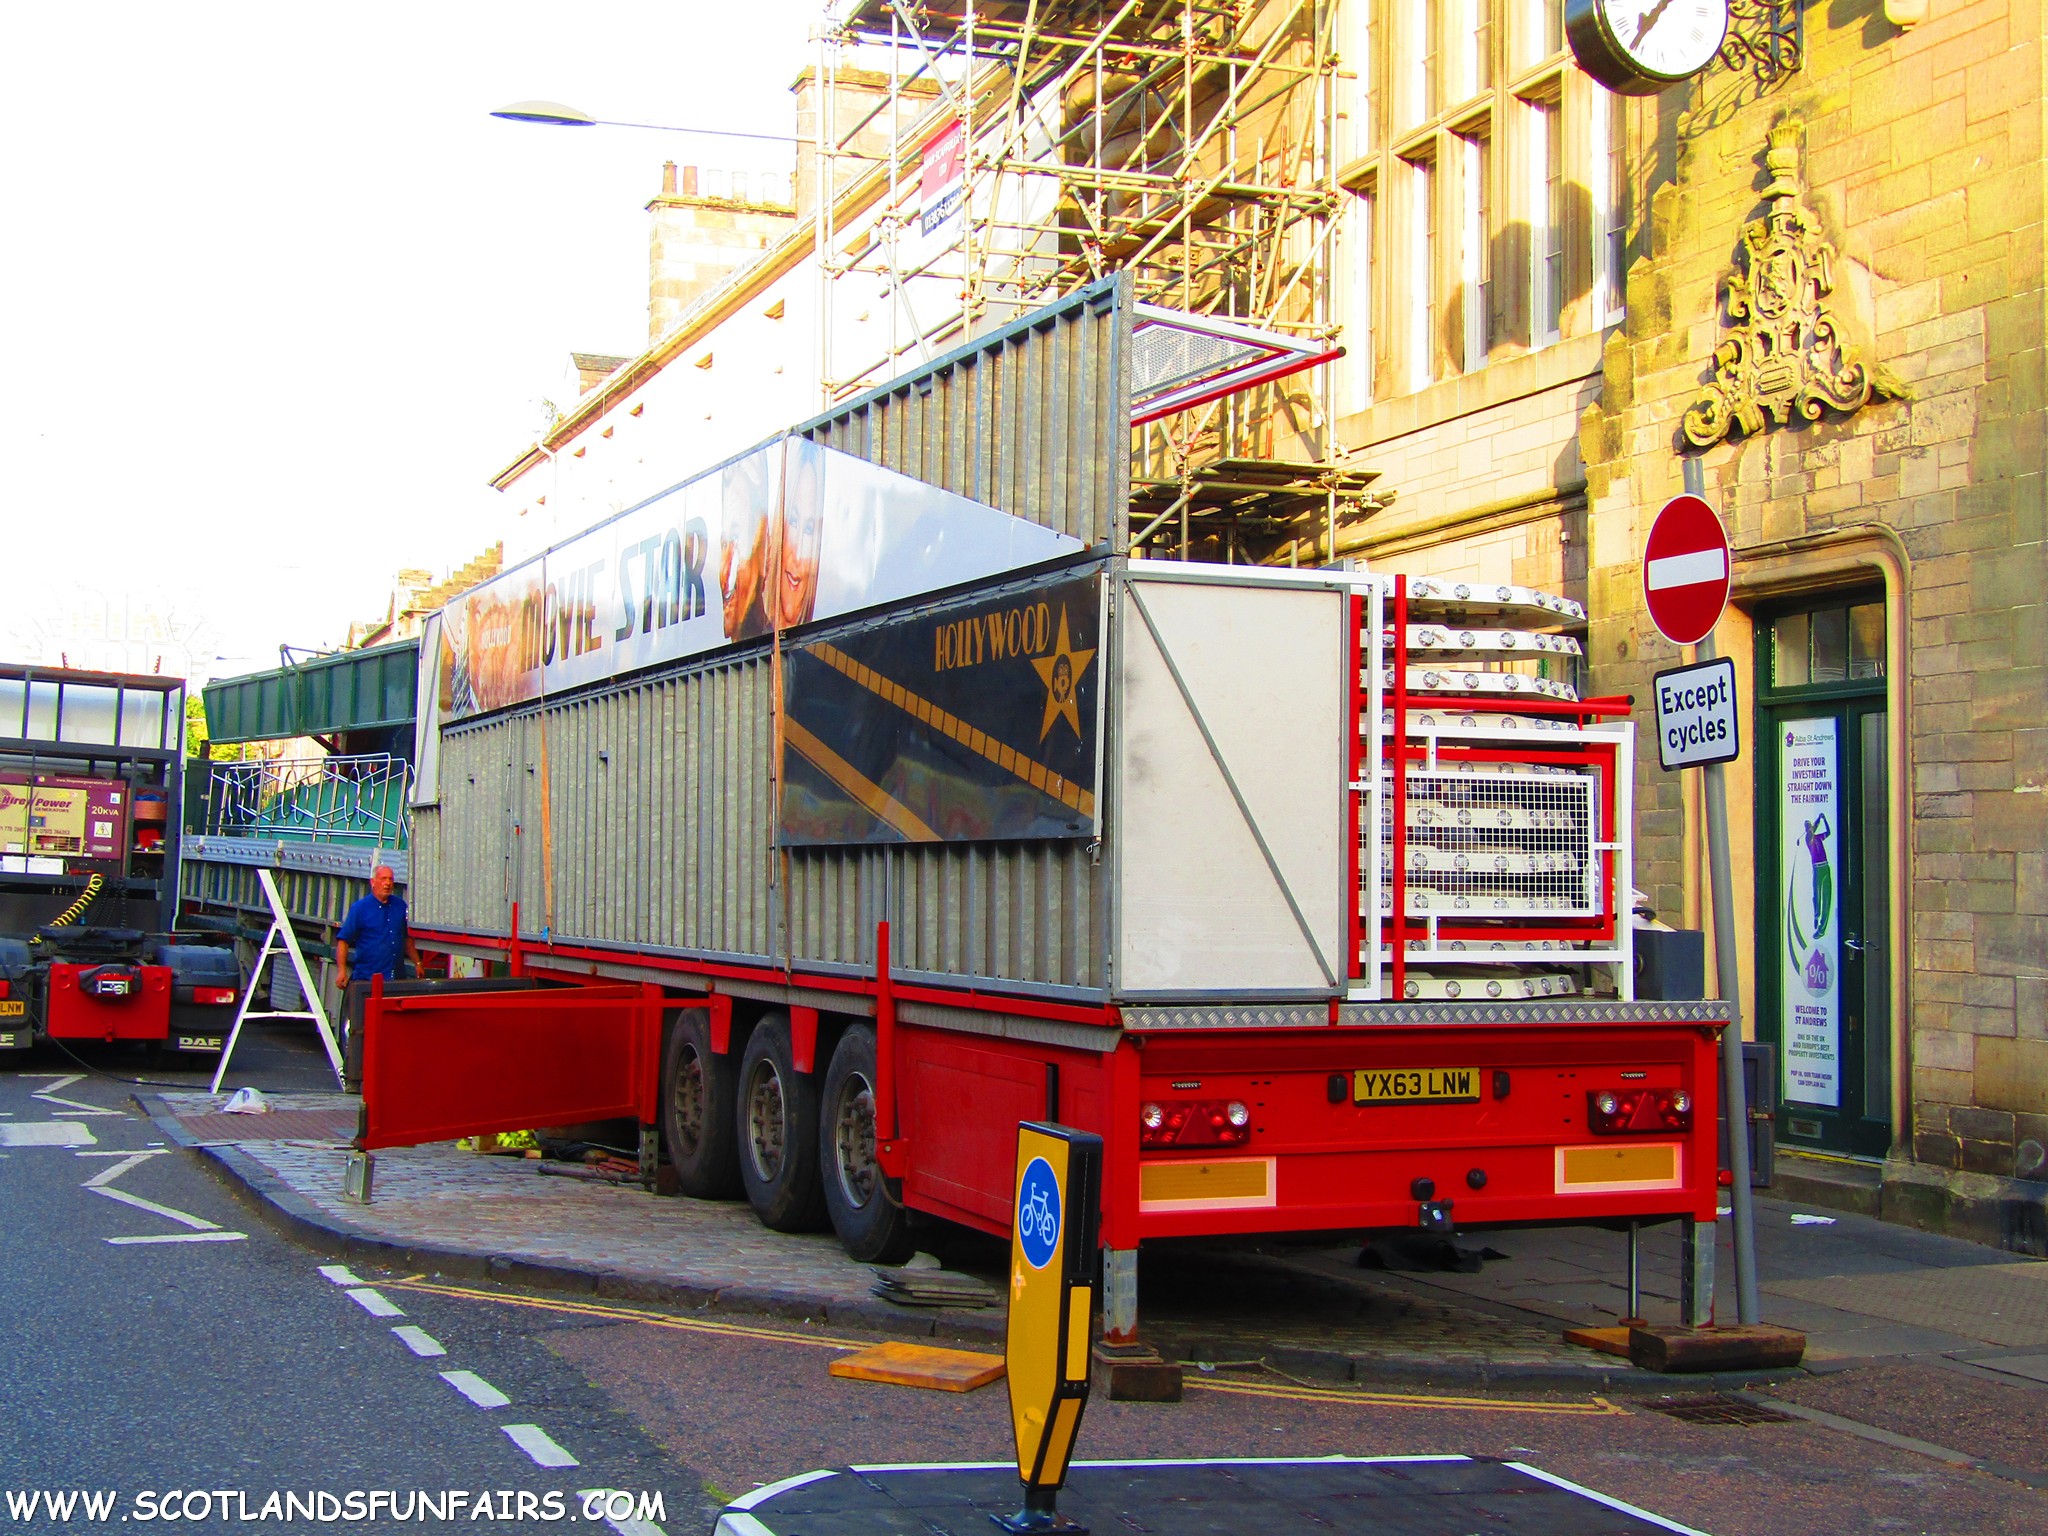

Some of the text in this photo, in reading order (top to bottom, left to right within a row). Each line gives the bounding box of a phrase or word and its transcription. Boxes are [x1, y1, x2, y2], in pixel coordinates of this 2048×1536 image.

[615, 516, 708, 642] STAR
[935, 602, 1050, 672] HOLLYWOOD
[1661, 675, 1727, 715] Except
[1668, 716, 1726, 752] cycles
[1793, 757, 1825, 767] DRIVE YOUR
[1792, 769, 1826, 779] INVESTMENT
[1787, 782, 1832, 791] STRAIGHT DOWN
[1, 796, 72, 808] Hire Power
[1791, 795, 1801, 803] THE
[92, 806, 119, 816] 20KVA
[1795, 1005, 1827, 1015] WELCOME TO
[1795, 1016, 1827, 1027] ST ANDREWS
[179, 1037, 221, 1046] DAF
[1809, 1052, 1834, 1060] INVESTMENTS
[1364, 1072, 1470, 1096] YX63 LNW
